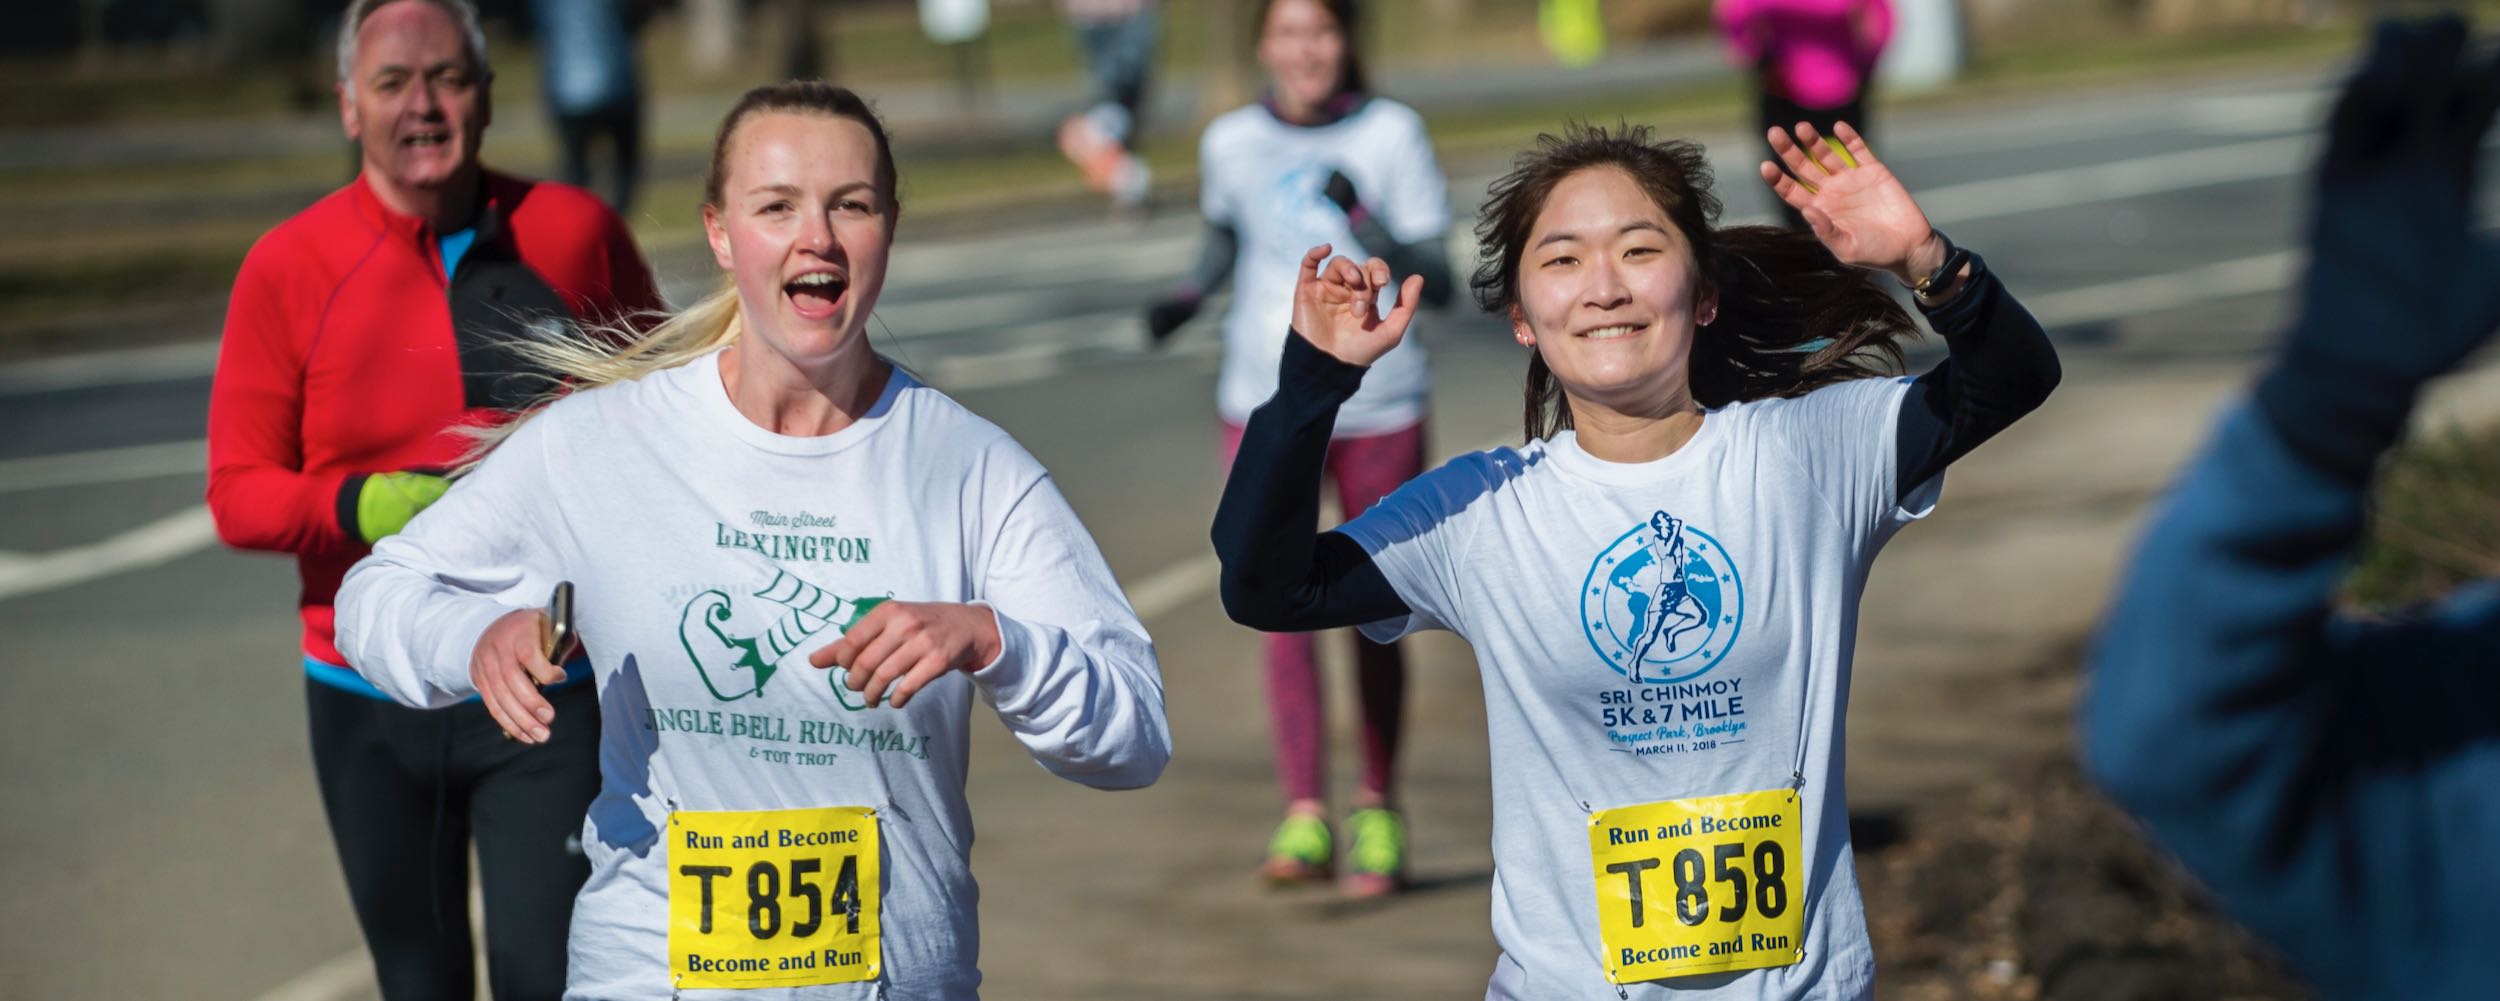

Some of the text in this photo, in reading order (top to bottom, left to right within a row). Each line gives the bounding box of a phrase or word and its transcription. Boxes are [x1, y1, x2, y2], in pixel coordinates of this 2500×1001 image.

[750, 510, 837, 529] Main Street
[716, 522, 871, 562] LEXINGTON
[1600, 678, 1742, 705] SRI CHINMOY
[1603, 706, 1637, 727] 5K
[1681, 696, 1744, 722] MILE
[730, 713, 791, 742] BELL
[1693, 719, 1748, 738] Brooklyn
[762, 750, 791, 764] TOT
[795, 752, 837, 766] TROT
[1636, 745, 1674, 756] MARCH
[1692, 740, 1716, 751] 2018
[686, 828, 859, 849] Run and Become
[1609, 814, 1782, 845] Run and Become
[688, 949, 862, 972] Become and Run
[1621, 933, 1788, 966] Become and Run
